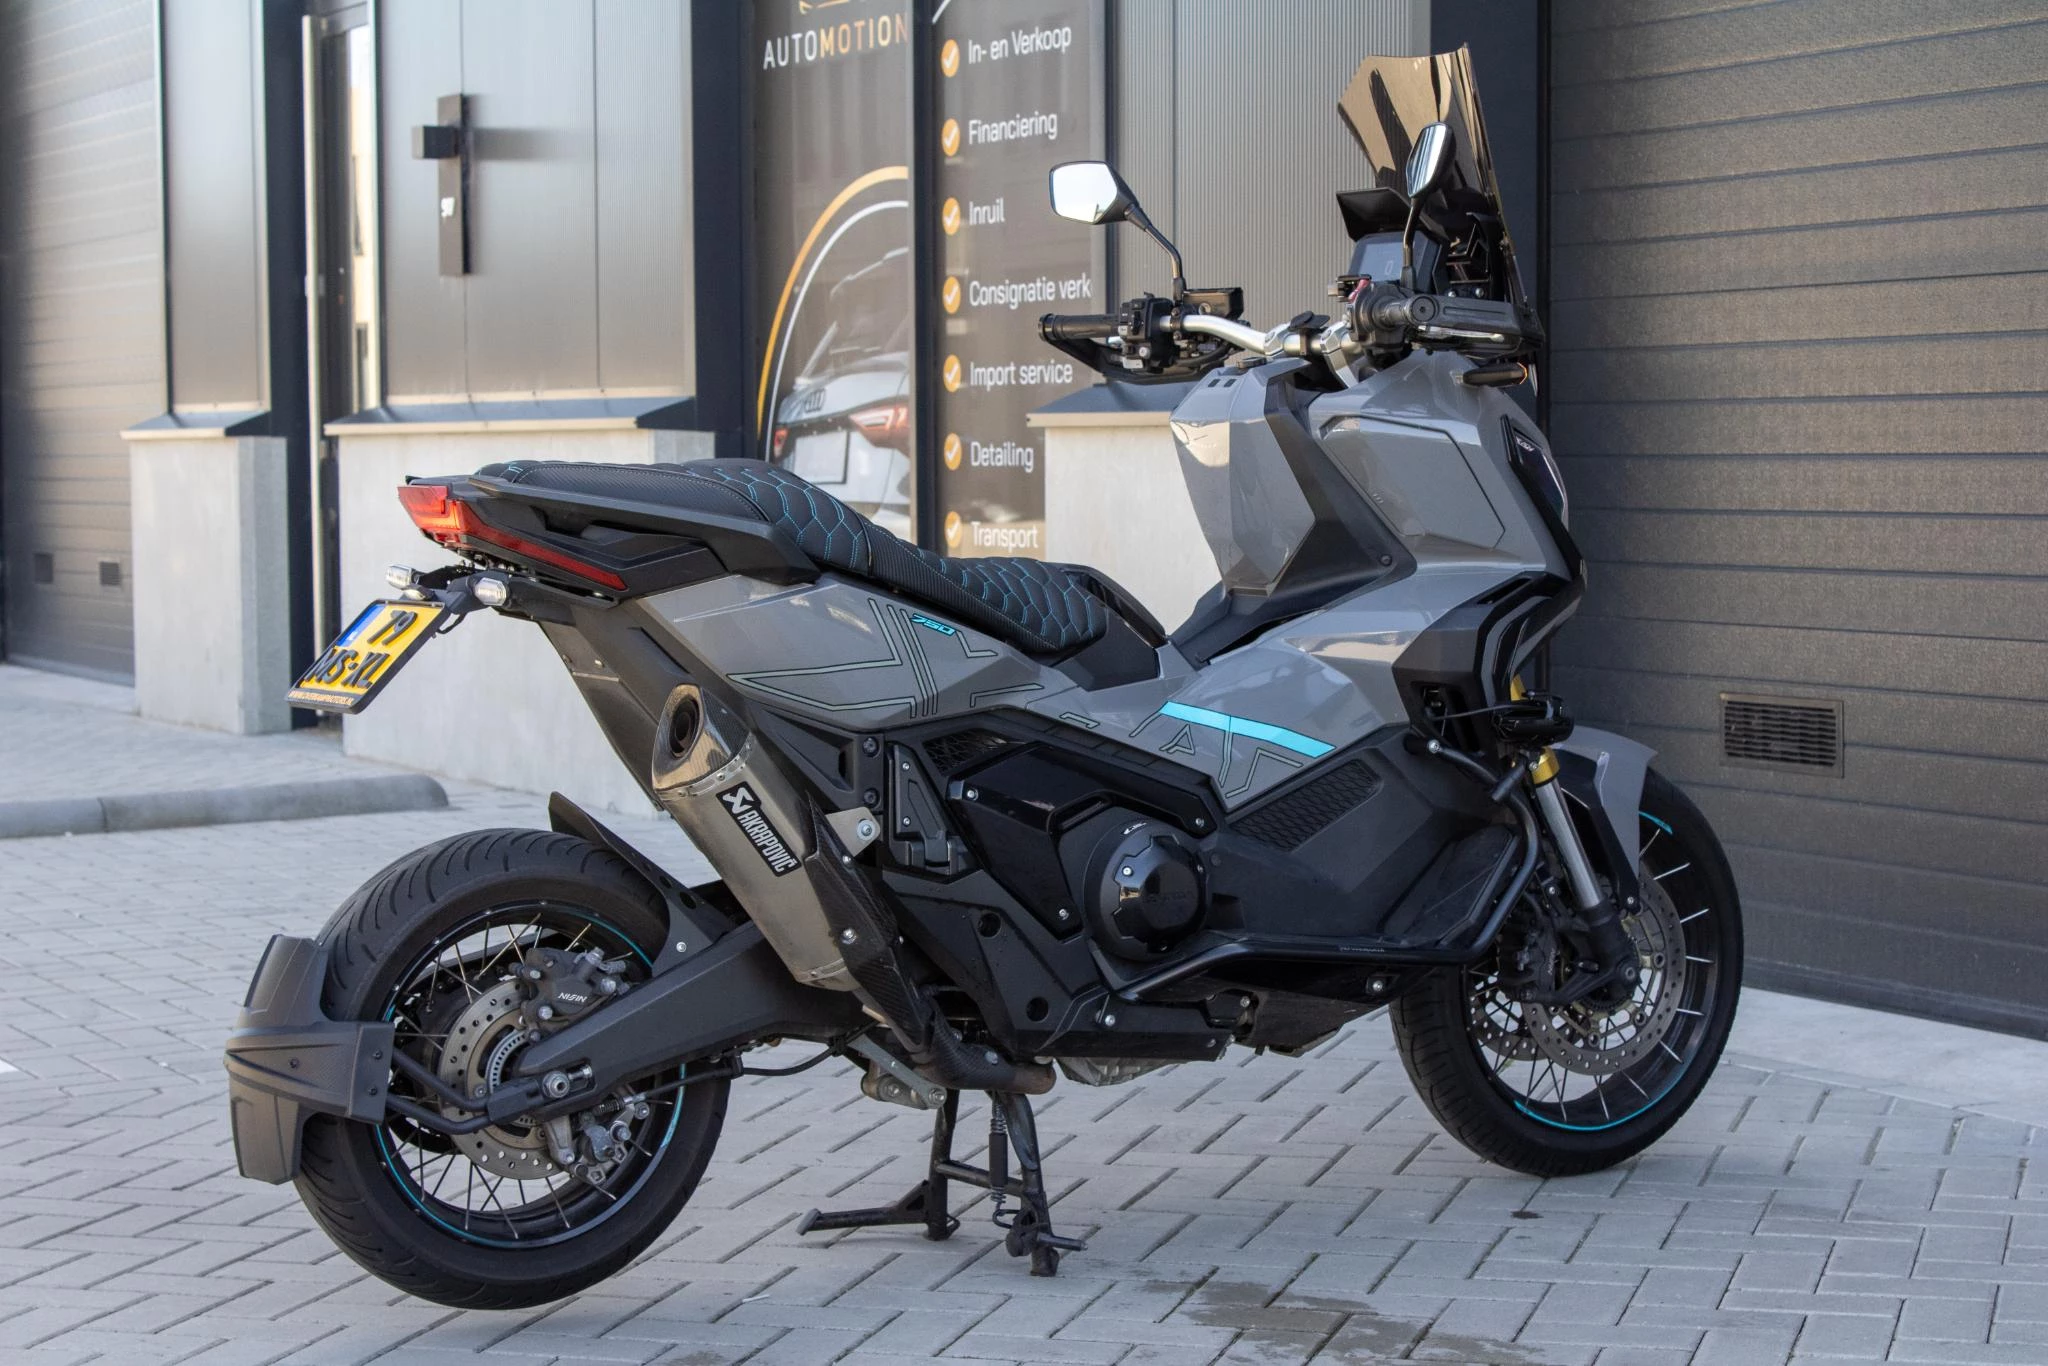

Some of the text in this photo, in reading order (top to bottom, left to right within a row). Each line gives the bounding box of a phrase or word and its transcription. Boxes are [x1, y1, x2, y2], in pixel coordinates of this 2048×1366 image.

[763, 11, 909, 70] AUTOMOTION
[968, 26, 1072, 65] In- en Verkoop
[968, 110, 1058, 145] Financiering
[969, 197, 1005, 226] Inruil
[969, 272, 1091, 310] Consignatie verk
[970, 359, 1073, 392] Import service
[971, 441, 1035, 473] Detailing
[971, 520, 1039, 553] Transport
[366, 610, 418, 646] 79
[911, 613, 956, 636] 750
